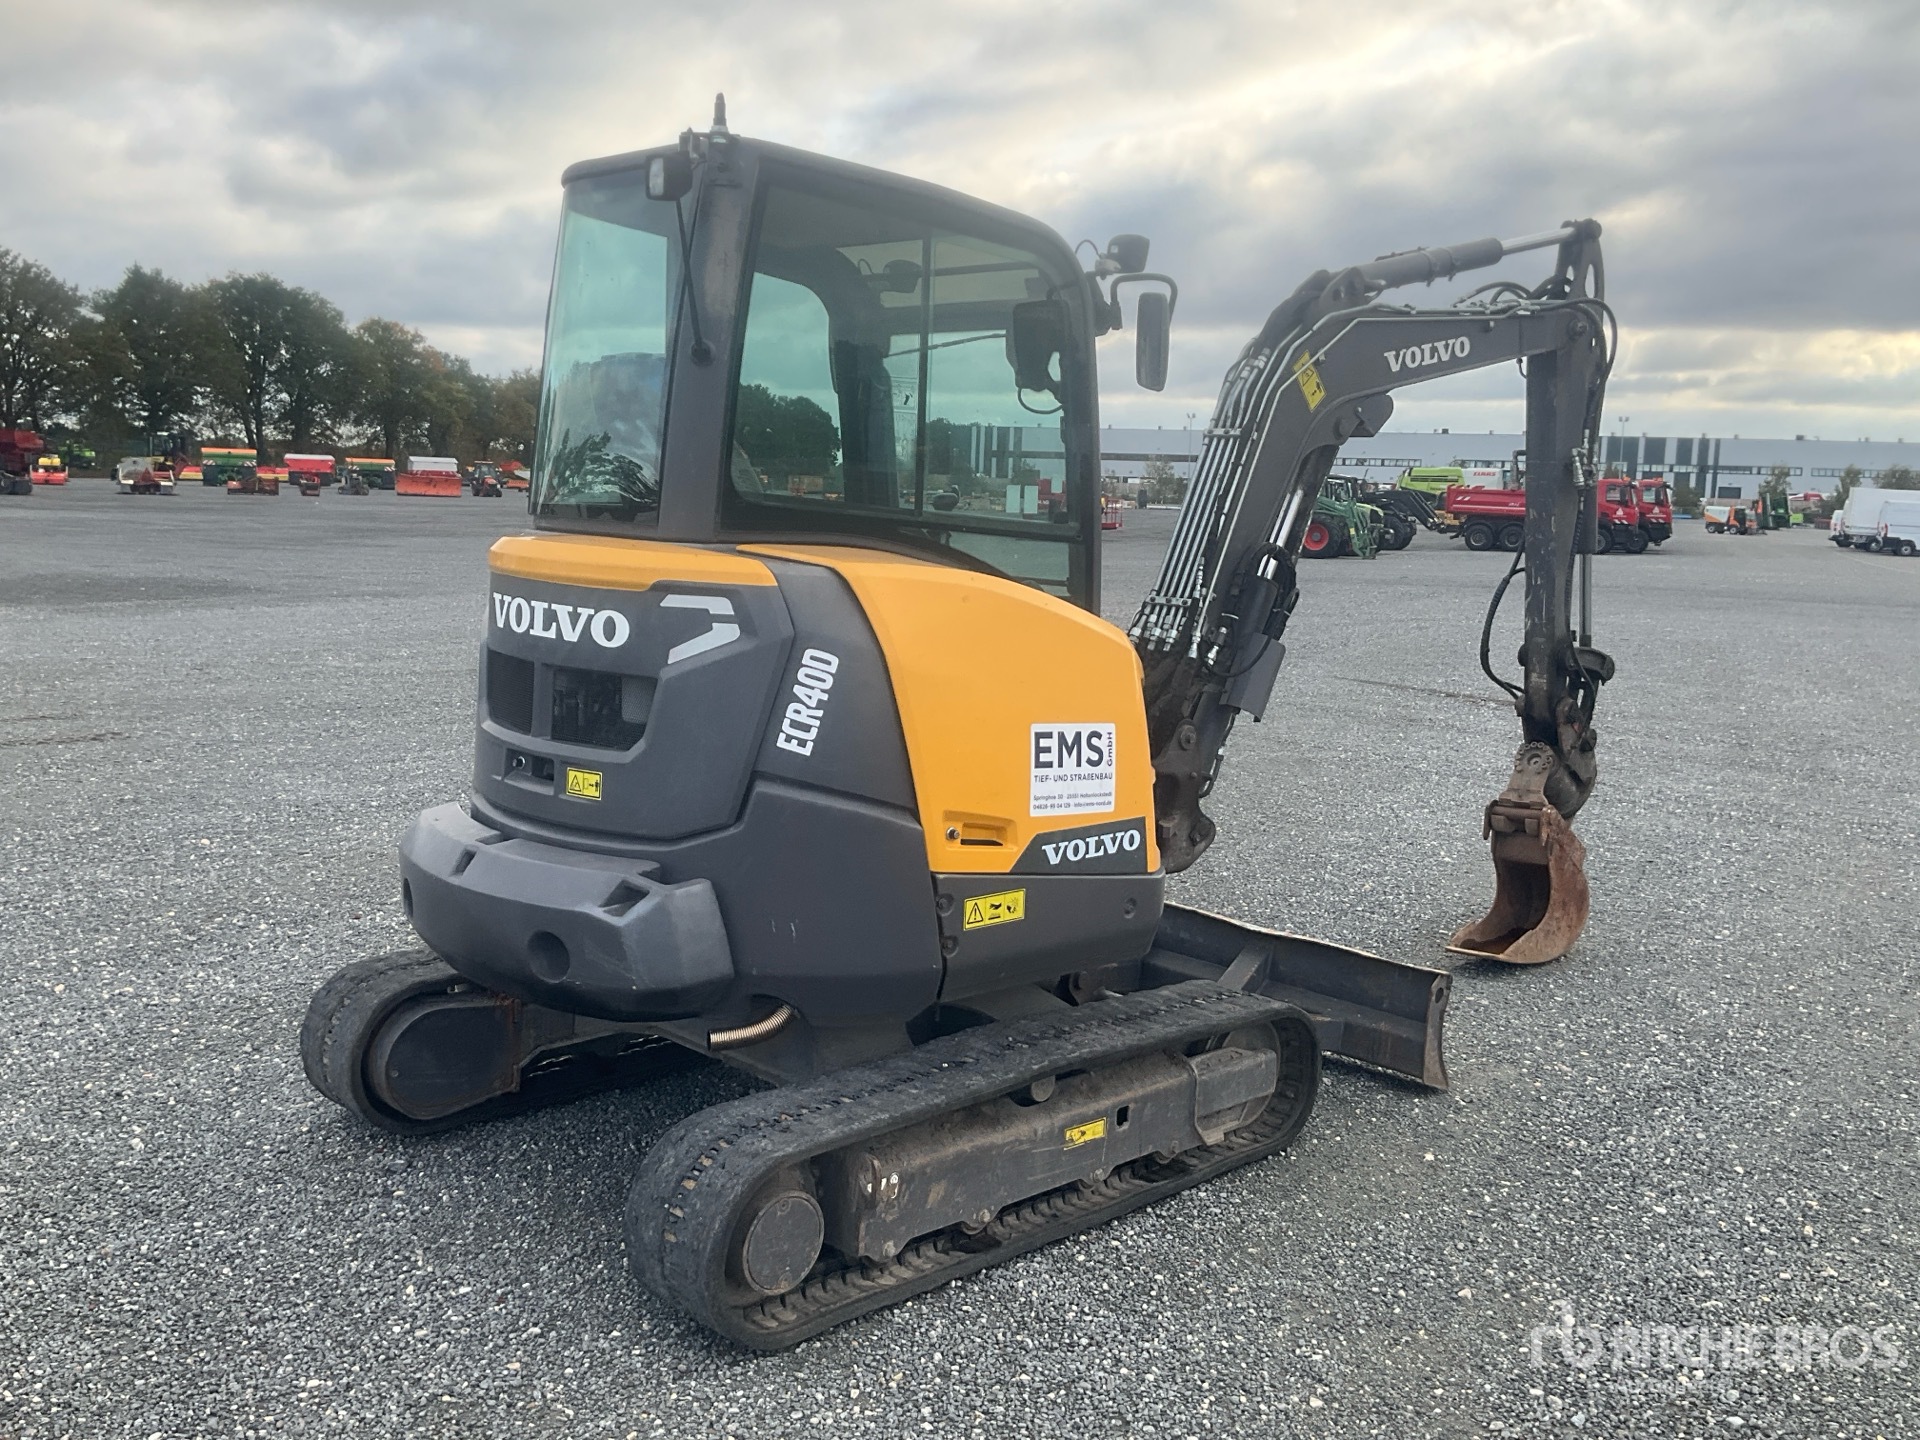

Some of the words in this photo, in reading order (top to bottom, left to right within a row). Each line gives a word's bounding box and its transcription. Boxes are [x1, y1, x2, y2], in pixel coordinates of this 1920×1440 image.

[1383, 336, 1471, 372] VOLVO
[493, 591, 630, 648] VOLVO
[776, 648, 840, 757] ECR40D
[1034, 730, 1104, 769] EMS
[1034, 774, 1052, 783] TIEF-
[1053, 773, 1069, 782] UND
[1042, 829, 1141, 865] VOLVO
